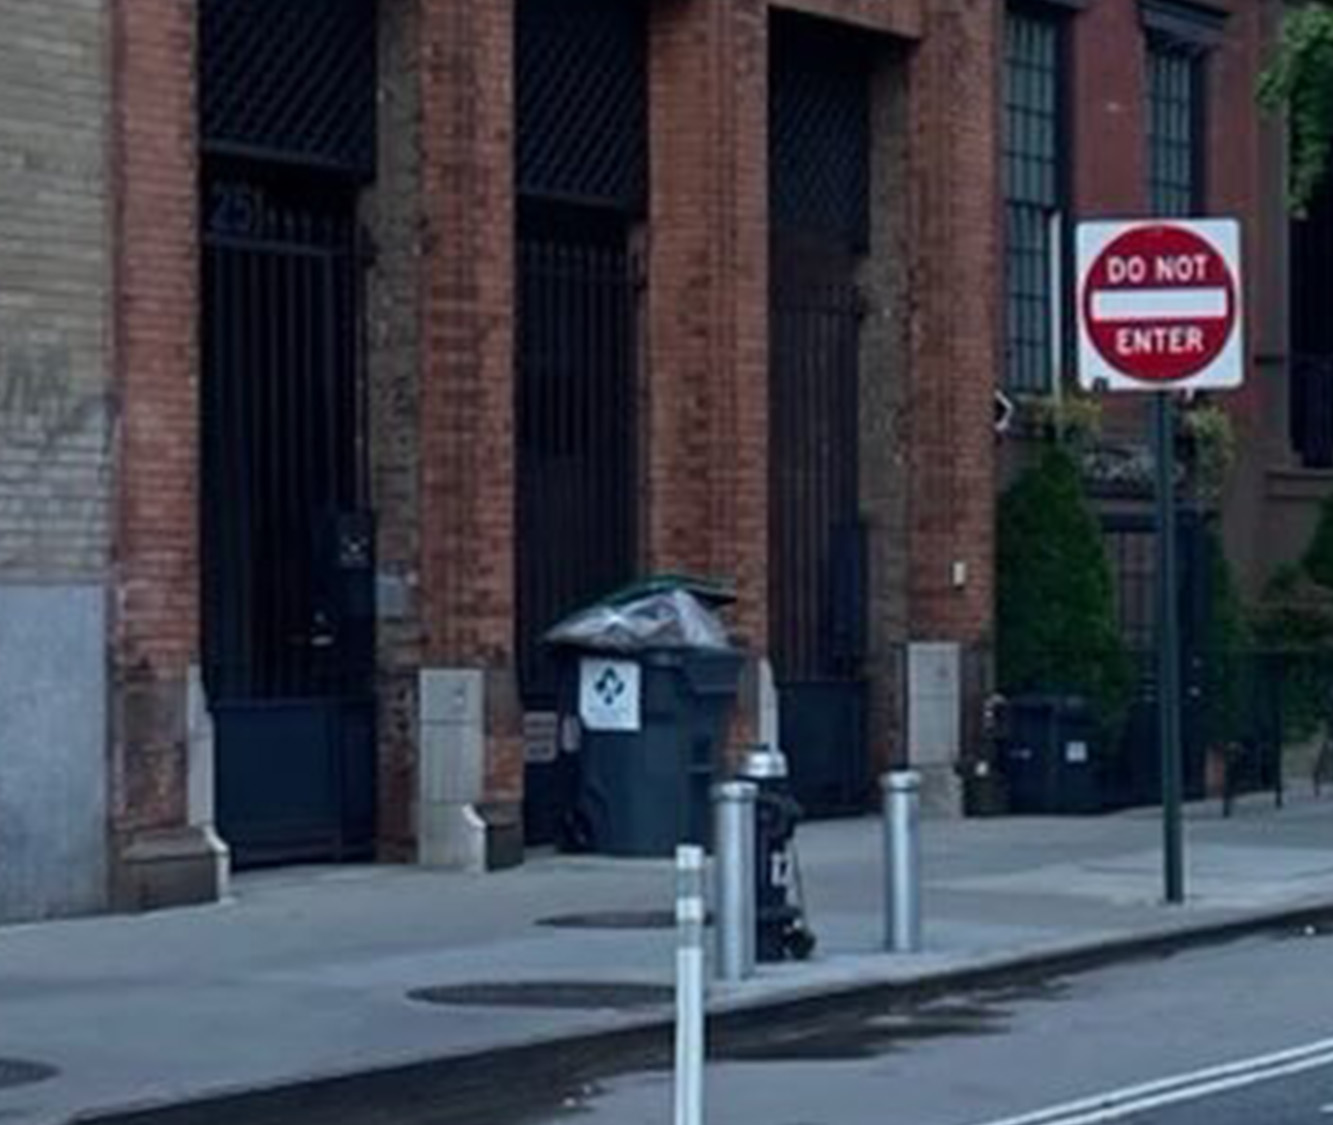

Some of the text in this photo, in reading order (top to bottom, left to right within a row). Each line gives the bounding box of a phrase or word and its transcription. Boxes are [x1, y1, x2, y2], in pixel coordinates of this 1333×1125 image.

[1106, 255, 1209, 283] DO NOT
[1115, 328, 1204, 354] ENTER
